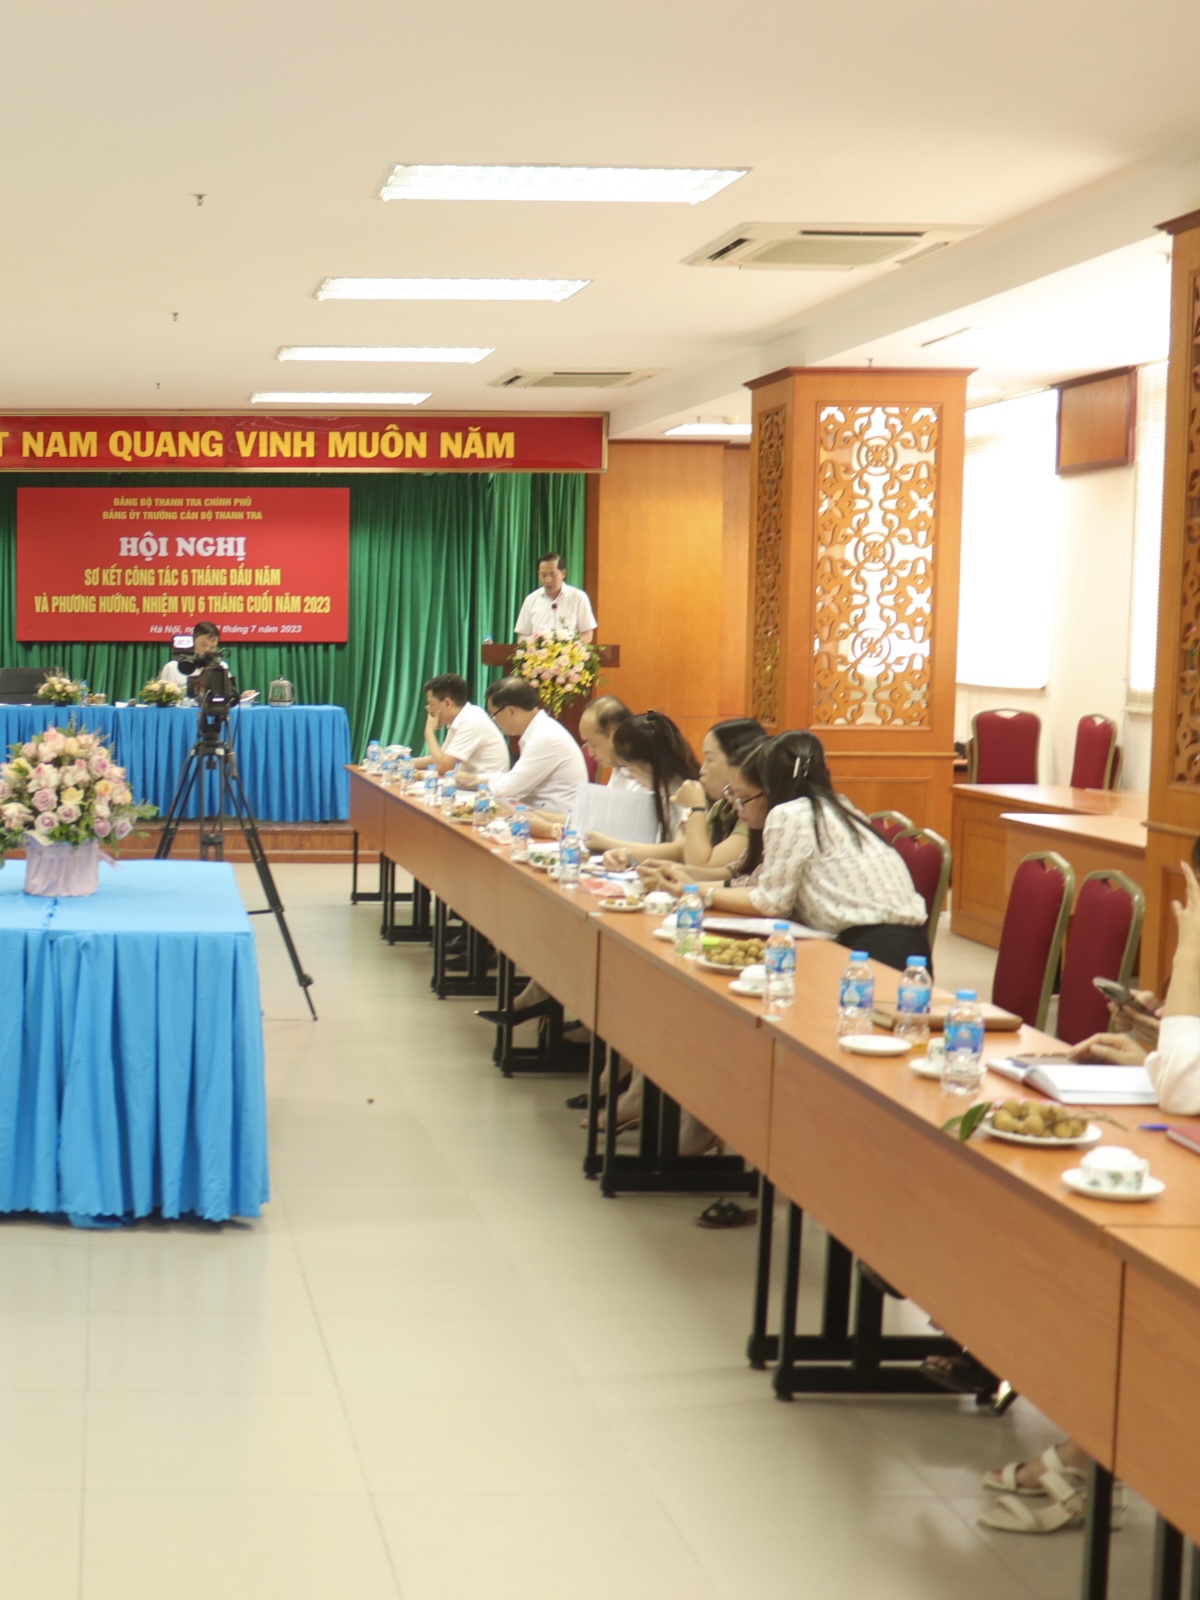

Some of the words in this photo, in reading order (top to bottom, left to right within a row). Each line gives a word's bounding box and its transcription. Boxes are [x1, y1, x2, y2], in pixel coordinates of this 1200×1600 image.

[22, 431, 98, 458] NAM
[108, 430, 224, 462] QUANG
[235, 431, 315, 458] VINH
[328, 424, 428, 459] MUÔN
[439, 426, 515, 459] NĂM
[154, 498, 184, 507] THANH
[186, 498, 202, 507] TRA
[215, 511, 244, 520] THANH
[246, 511, 263, 520] TRA
[119, 530, 169, 562] HỘI
[175, 536, 247, 562] NGHỊ
[84, 566, 100, 586] SƠ
[102, 563, 122, 586] KẾT
[125, 565, 155, 586] CÔNG
[157, 565, 179, 586] TÁC
[181, 569, 189, 586] 6
[191, 565, 228, 586] THÁNG
[229, 563, 253, 586] ĐẦU
[255, 565, 281, 586] NĂM
[34, 592, 49, 613] VÀ
[51, 593, 97, 613] PHƯƠNG
[99, 592, 140, 615] HƯỚNG,
[142, 592, 179, 617] NHIỆM
[180, 596, 196, 617] VỤ
[198, 596, 206, 613] 6
[208, 592, 244, 613] THÁNG
[246, 589, 273, 613] CUỐI
[275, 592, 301, 613] NĂM
[303, 596, 331, 613] 2023
[149, 625, 163, 633] Hà
[222, 624, 249, 635] tháng
[250, 625, 258, 633] 7
[258, 625, 279, 633] năm
[280, 624, 303, 633] 2023
